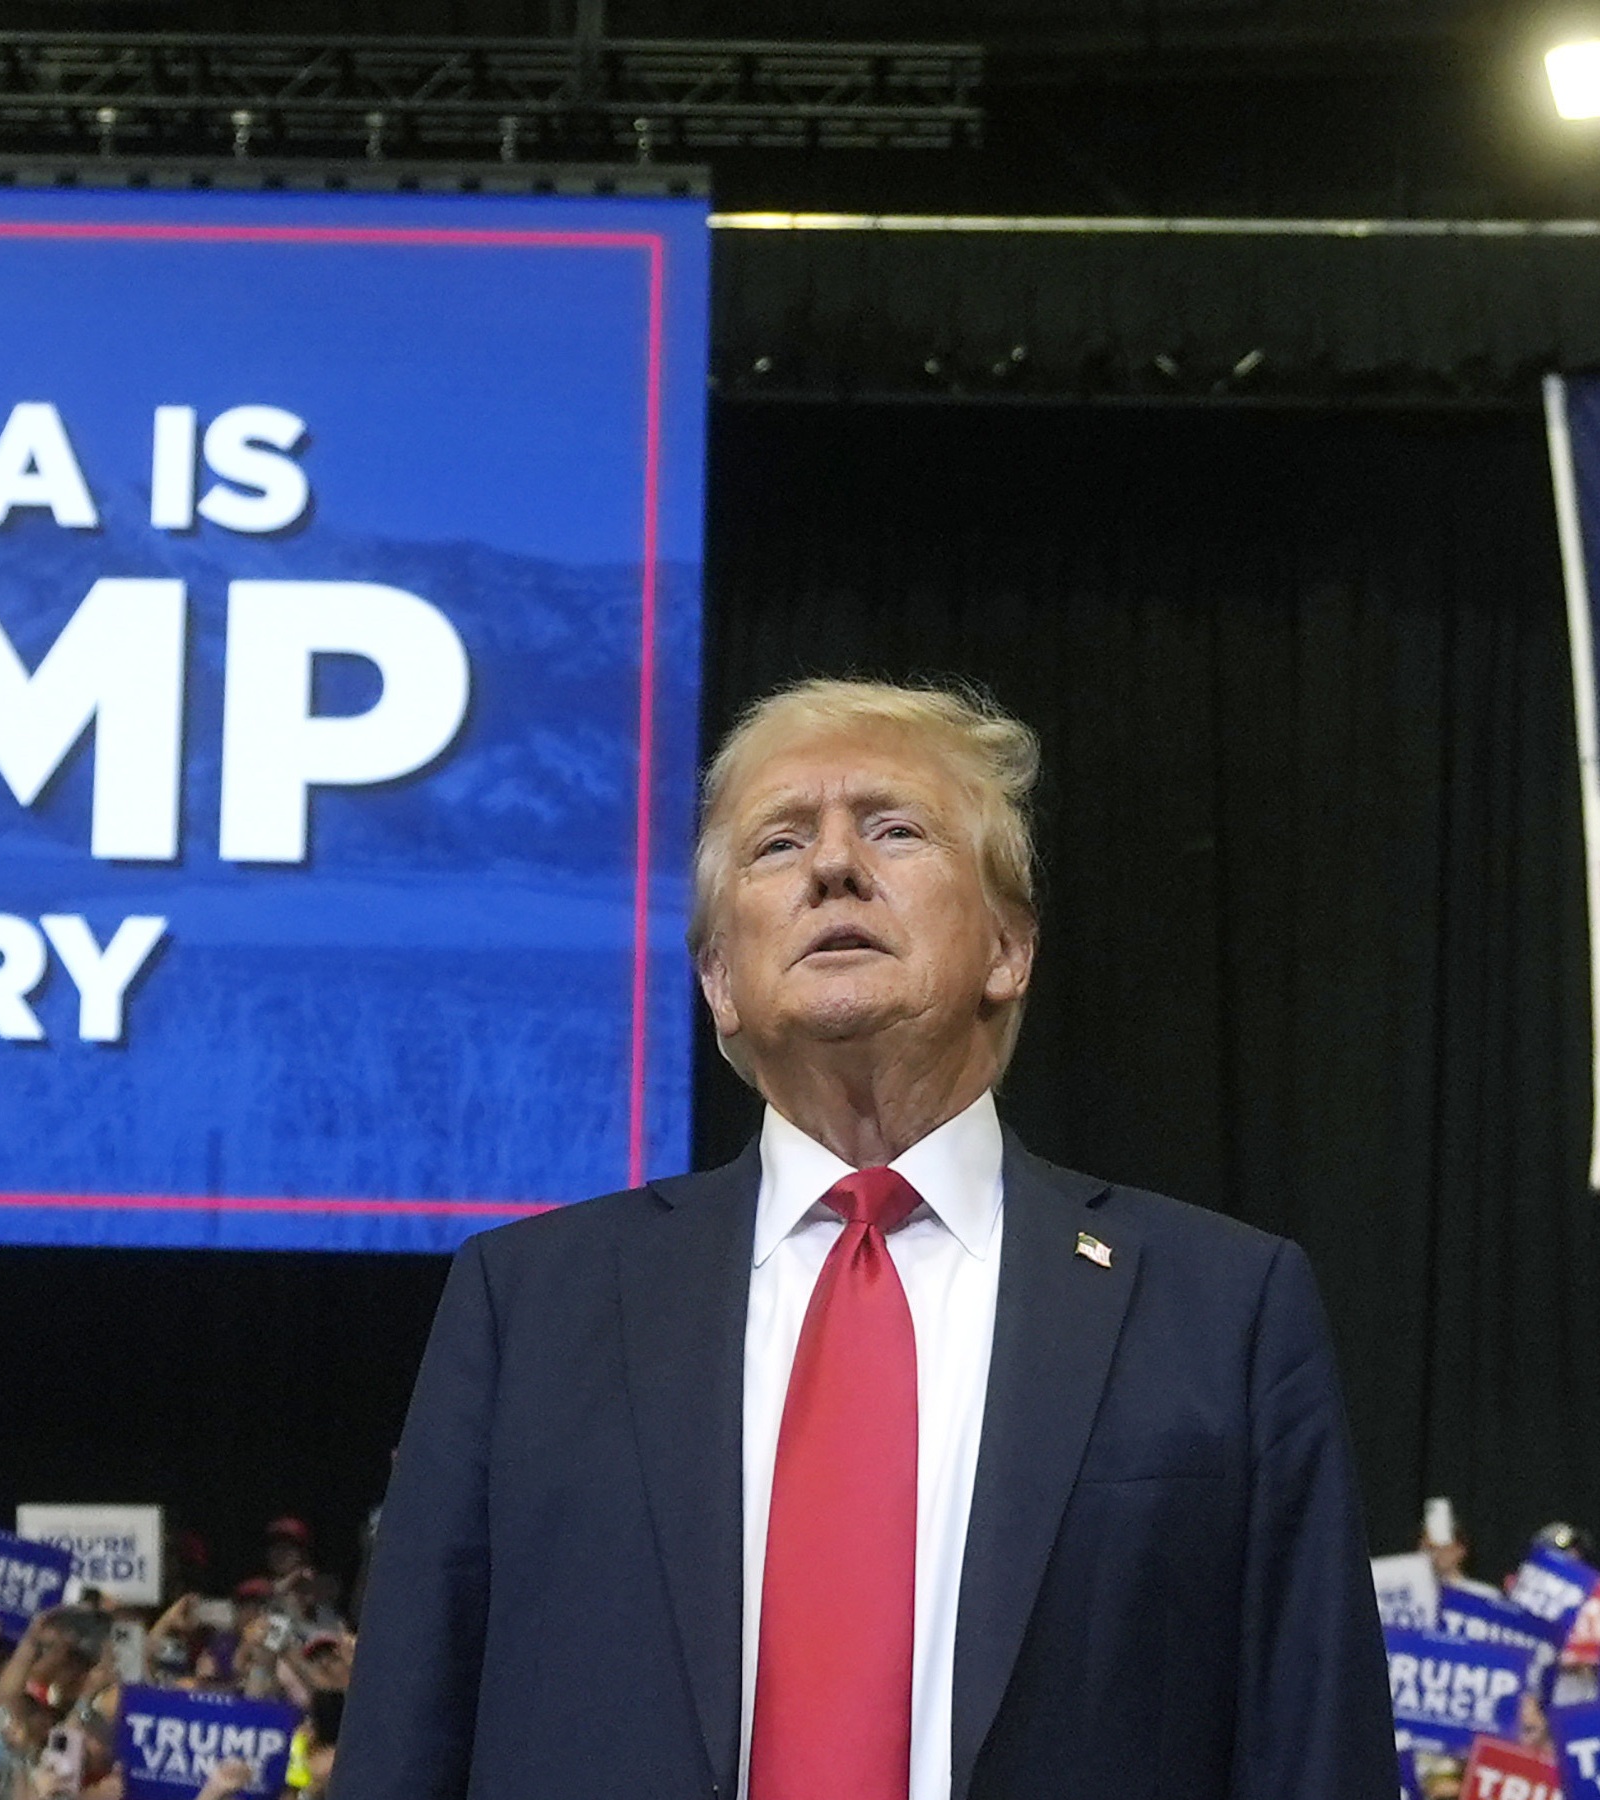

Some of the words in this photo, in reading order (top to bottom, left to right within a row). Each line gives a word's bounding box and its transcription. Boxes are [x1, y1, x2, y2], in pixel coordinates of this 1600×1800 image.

[152, 403, 310, 534] IS
[1389, 1652, 1520, 1700] RUMP
[1393, 1684, 1495, 1724] ANCE
[125, 1713, 286, 1757] TRUMP
